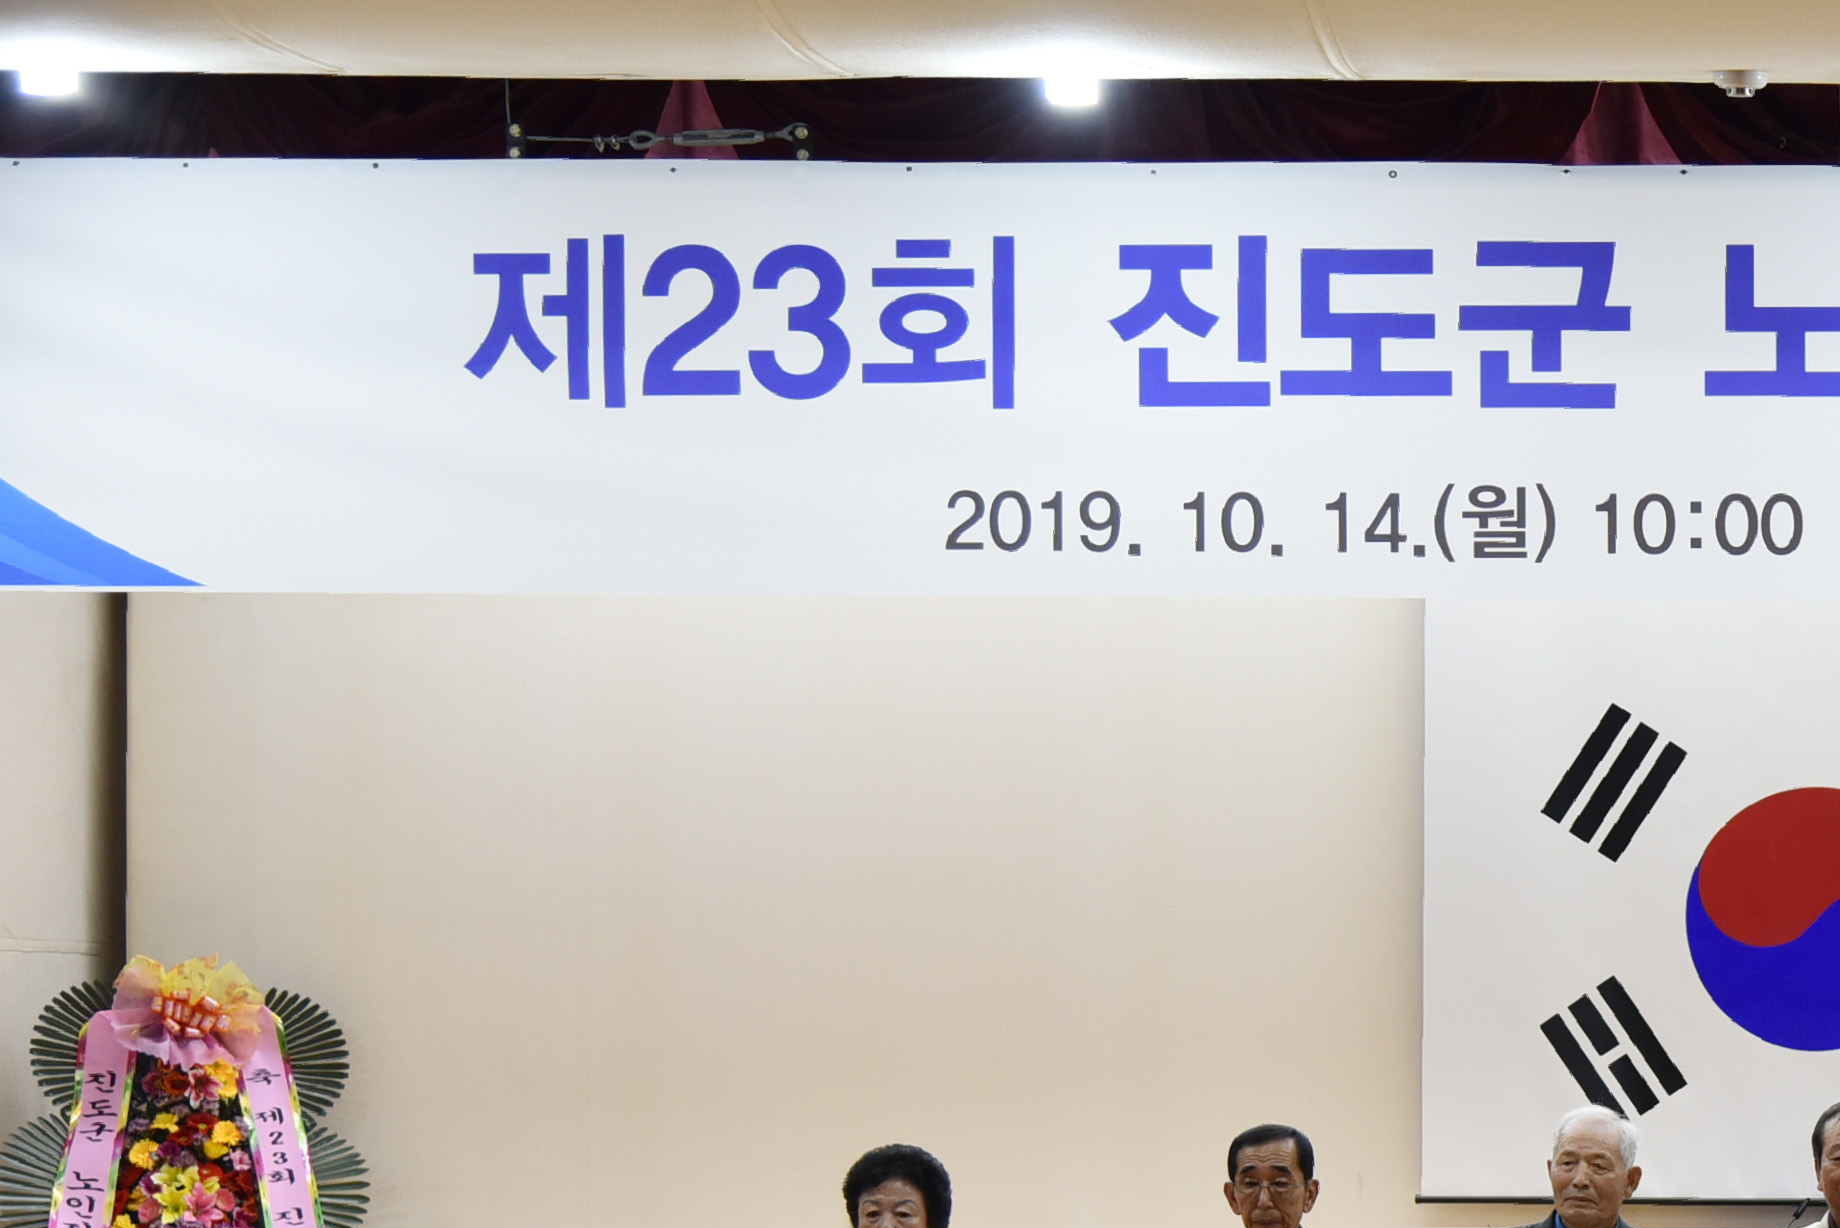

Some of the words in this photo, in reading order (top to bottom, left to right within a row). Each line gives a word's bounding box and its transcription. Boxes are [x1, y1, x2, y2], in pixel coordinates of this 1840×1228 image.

[465, 234, 1016, 409] 제23회
[1110, 235, 1632, 409] 진도군
[945, 490, 1142, 556] 2019.
[1183, 491, 1284, 557] 10.
[1595, 493, 1804, 556] 10:00
[79, 1070, 117, 1142] 진도군
[247, 1068, 281, 1086] 축
[255, 1106, 296, 1186] 제23회
